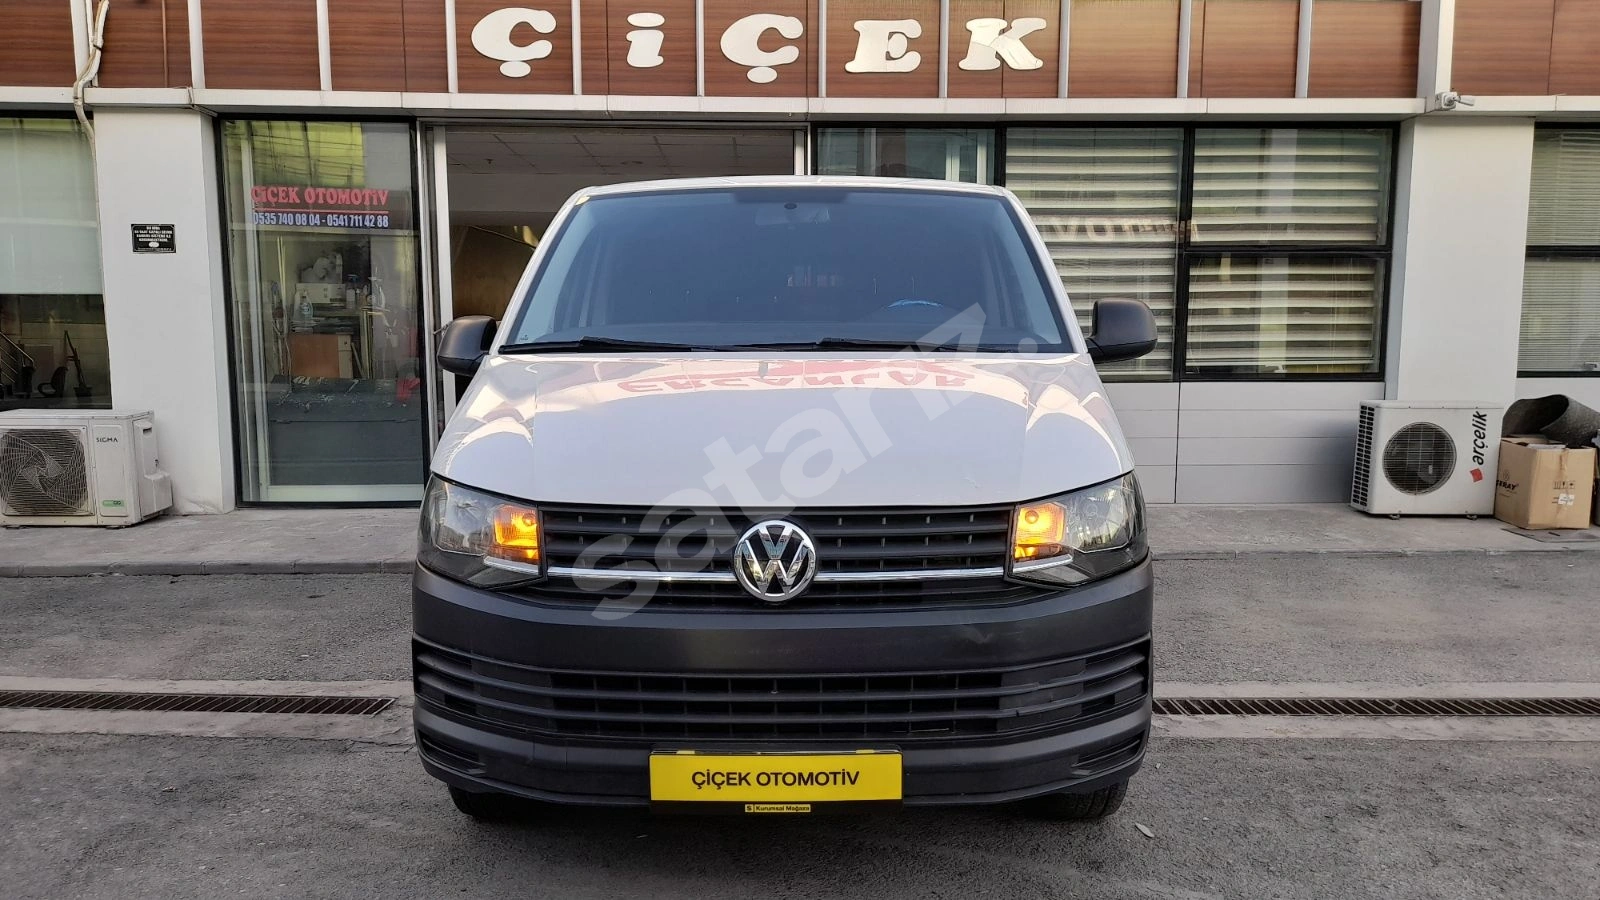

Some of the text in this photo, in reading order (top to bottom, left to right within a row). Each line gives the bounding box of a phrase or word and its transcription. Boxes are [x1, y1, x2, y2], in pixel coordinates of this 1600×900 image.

[253, 212, 276, 225] 0535
[279, 212, 293, 225] 740
[296, 213, 307, 226] 08
[309, 213, 320, 226] 04
[327, 214, 348, 227] 0541
[349, 214, 362, 227] 711
[364, 215, 375, 227] 42
[377, 215, 389, 228] 88
[1472, 411, 1488, 465] arçelik
[691, 768, 860, 790] ÇİÇEK OTOMOTİV
